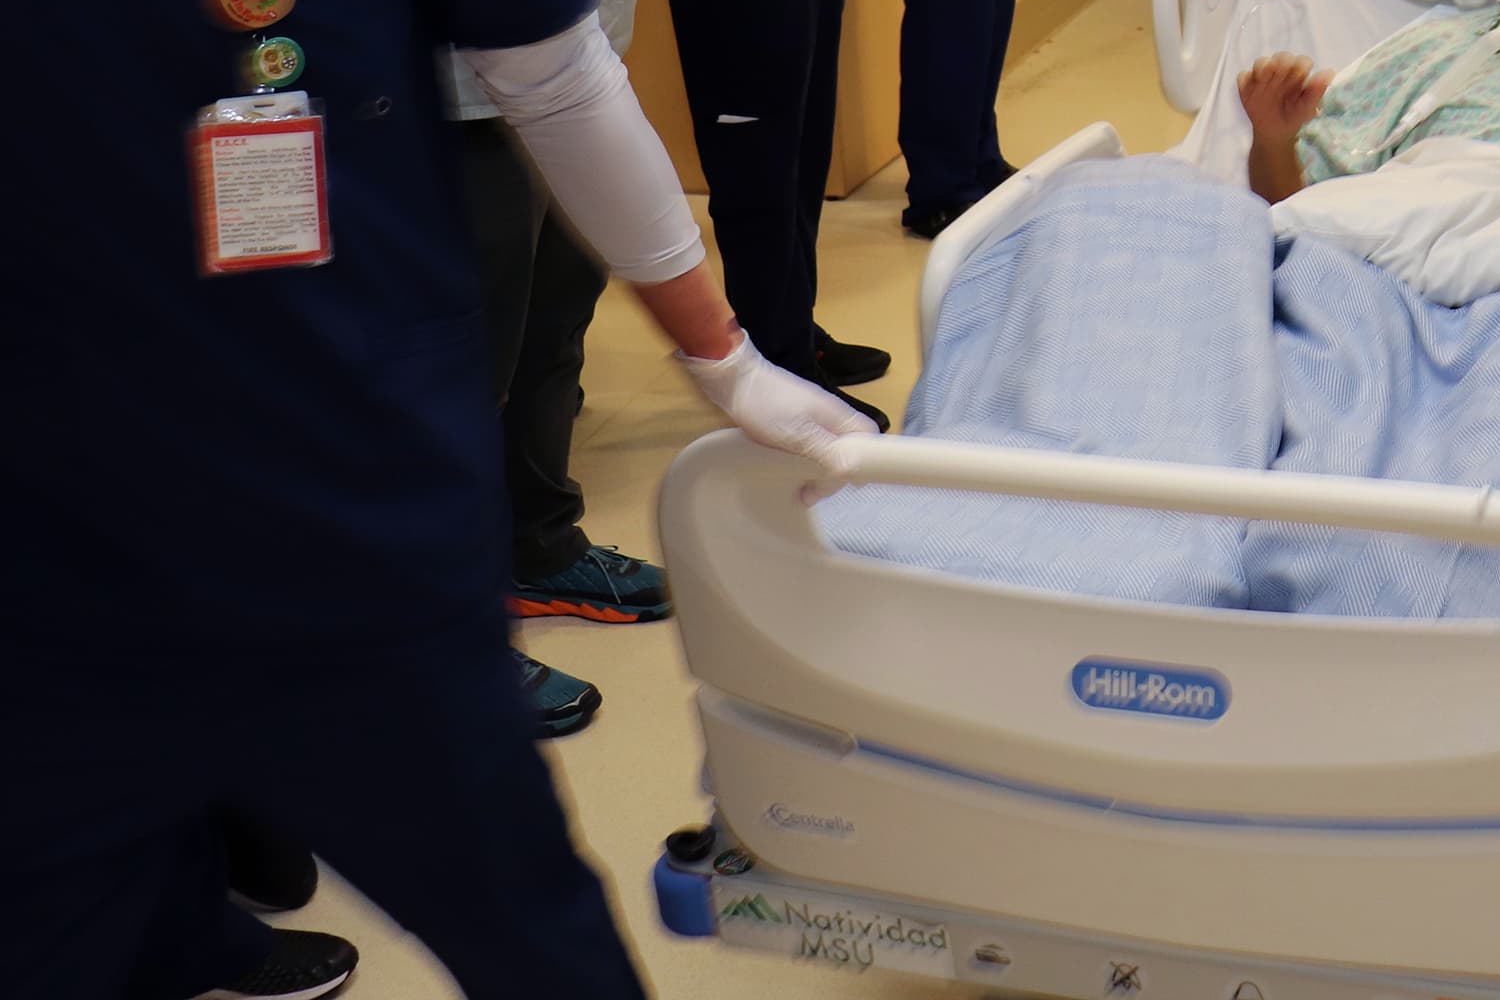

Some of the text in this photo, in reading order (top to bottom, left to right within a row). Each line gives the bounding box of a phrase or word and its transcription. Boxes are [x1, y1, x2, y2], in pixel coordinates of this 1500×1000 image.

[1088, 667, 1216, 707] Hill-Rom
[783, 899, 948, 950] Natividad
[800, 932, 875, 968] MSU
